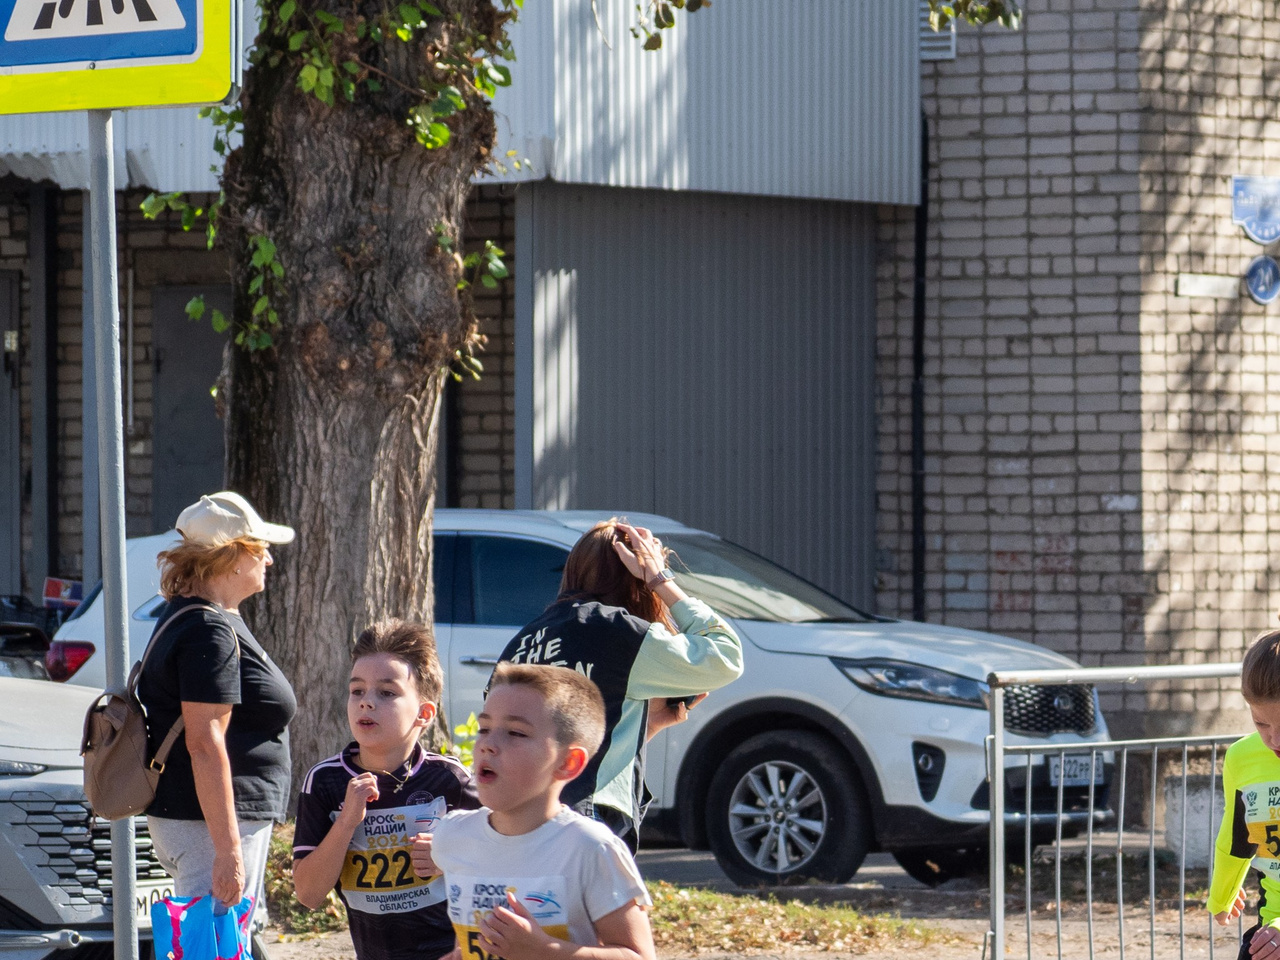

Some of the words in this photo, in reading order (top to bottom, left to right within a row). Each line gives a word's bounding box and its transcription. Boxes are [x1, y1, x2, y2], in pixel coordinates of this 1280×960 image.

[516, 626, 549, 653] IN
[511, 638, 562, 664] THE
[364, 814, 395, 826] КРОСС
[364, 822, 406, 836] НАЦИИ
[367, 834, 409, 848] 2024
[352, 850, 433, 888] 222
[365, 888, 430, 903] ВЛАДИМИРСКАЯ
[380, 901, 418, 911] ОБЛАСТЬ
